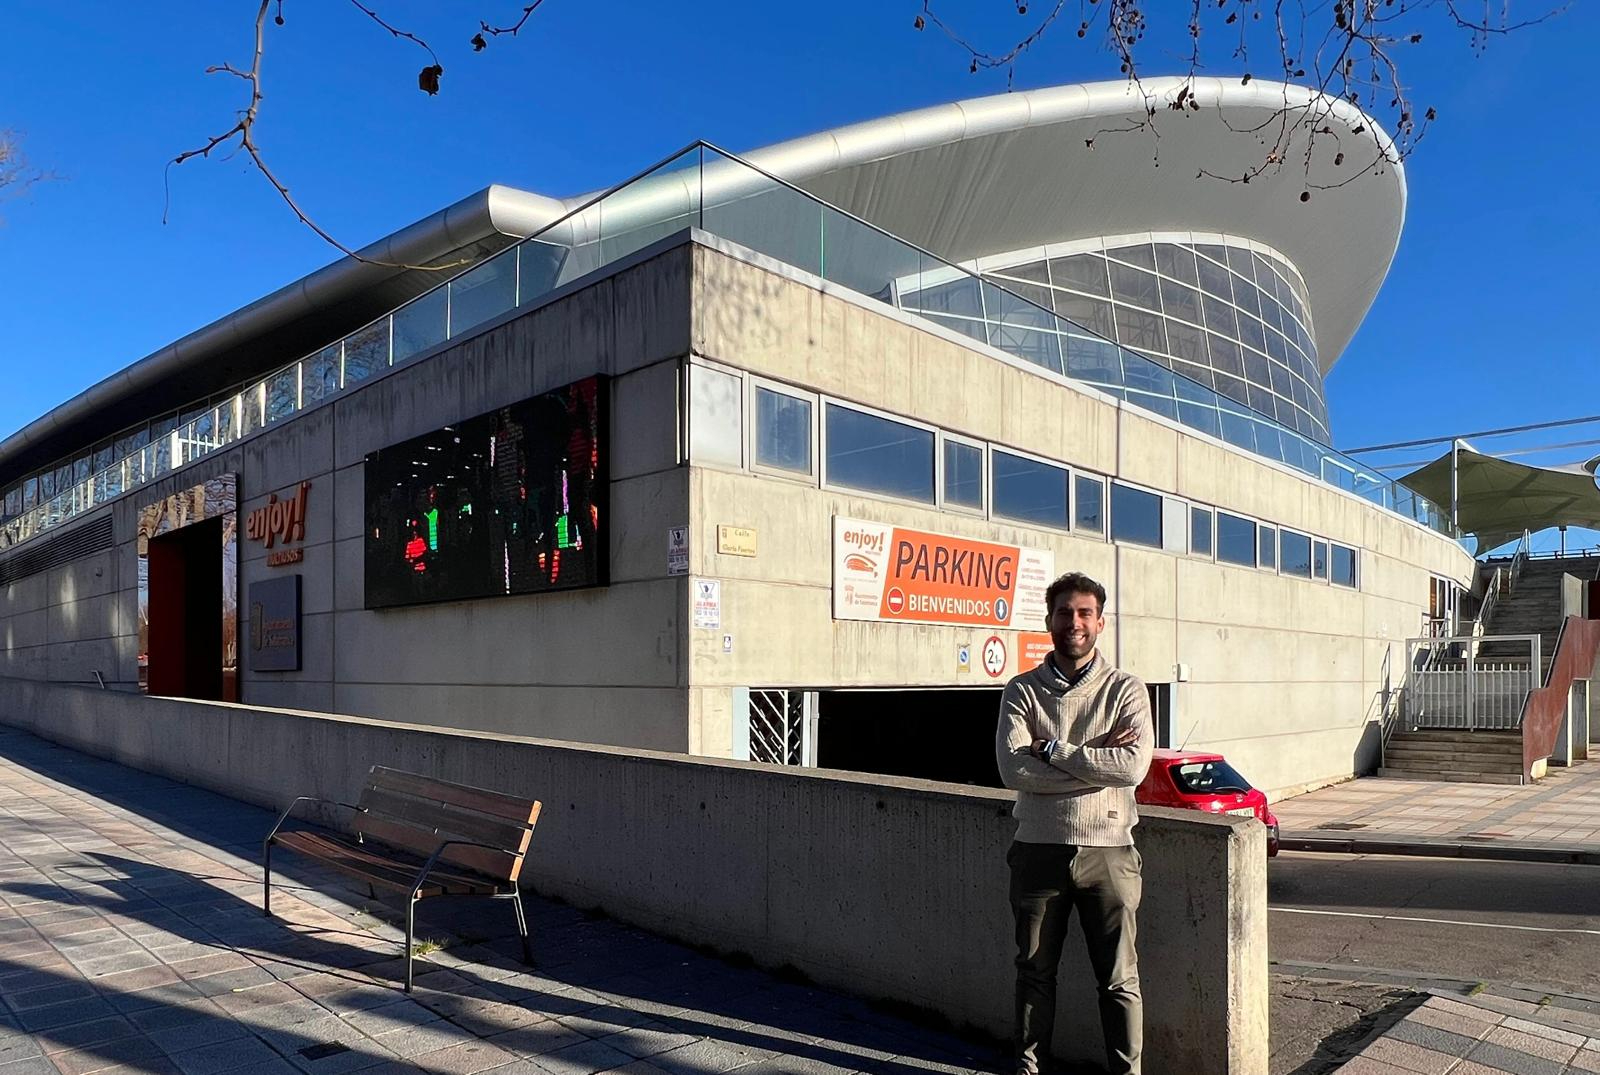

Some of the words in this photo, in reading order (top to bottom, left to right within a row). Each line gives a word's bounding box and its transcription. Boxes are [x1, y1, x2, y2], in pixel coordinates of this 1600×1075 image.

[246, 481, 308, 549] enjoy!
[844, 529, 884, 551] enjoy!
[896, 541, 1011, 590] PARKING
[909, 594, 990, 617] BIENVENIDOS
